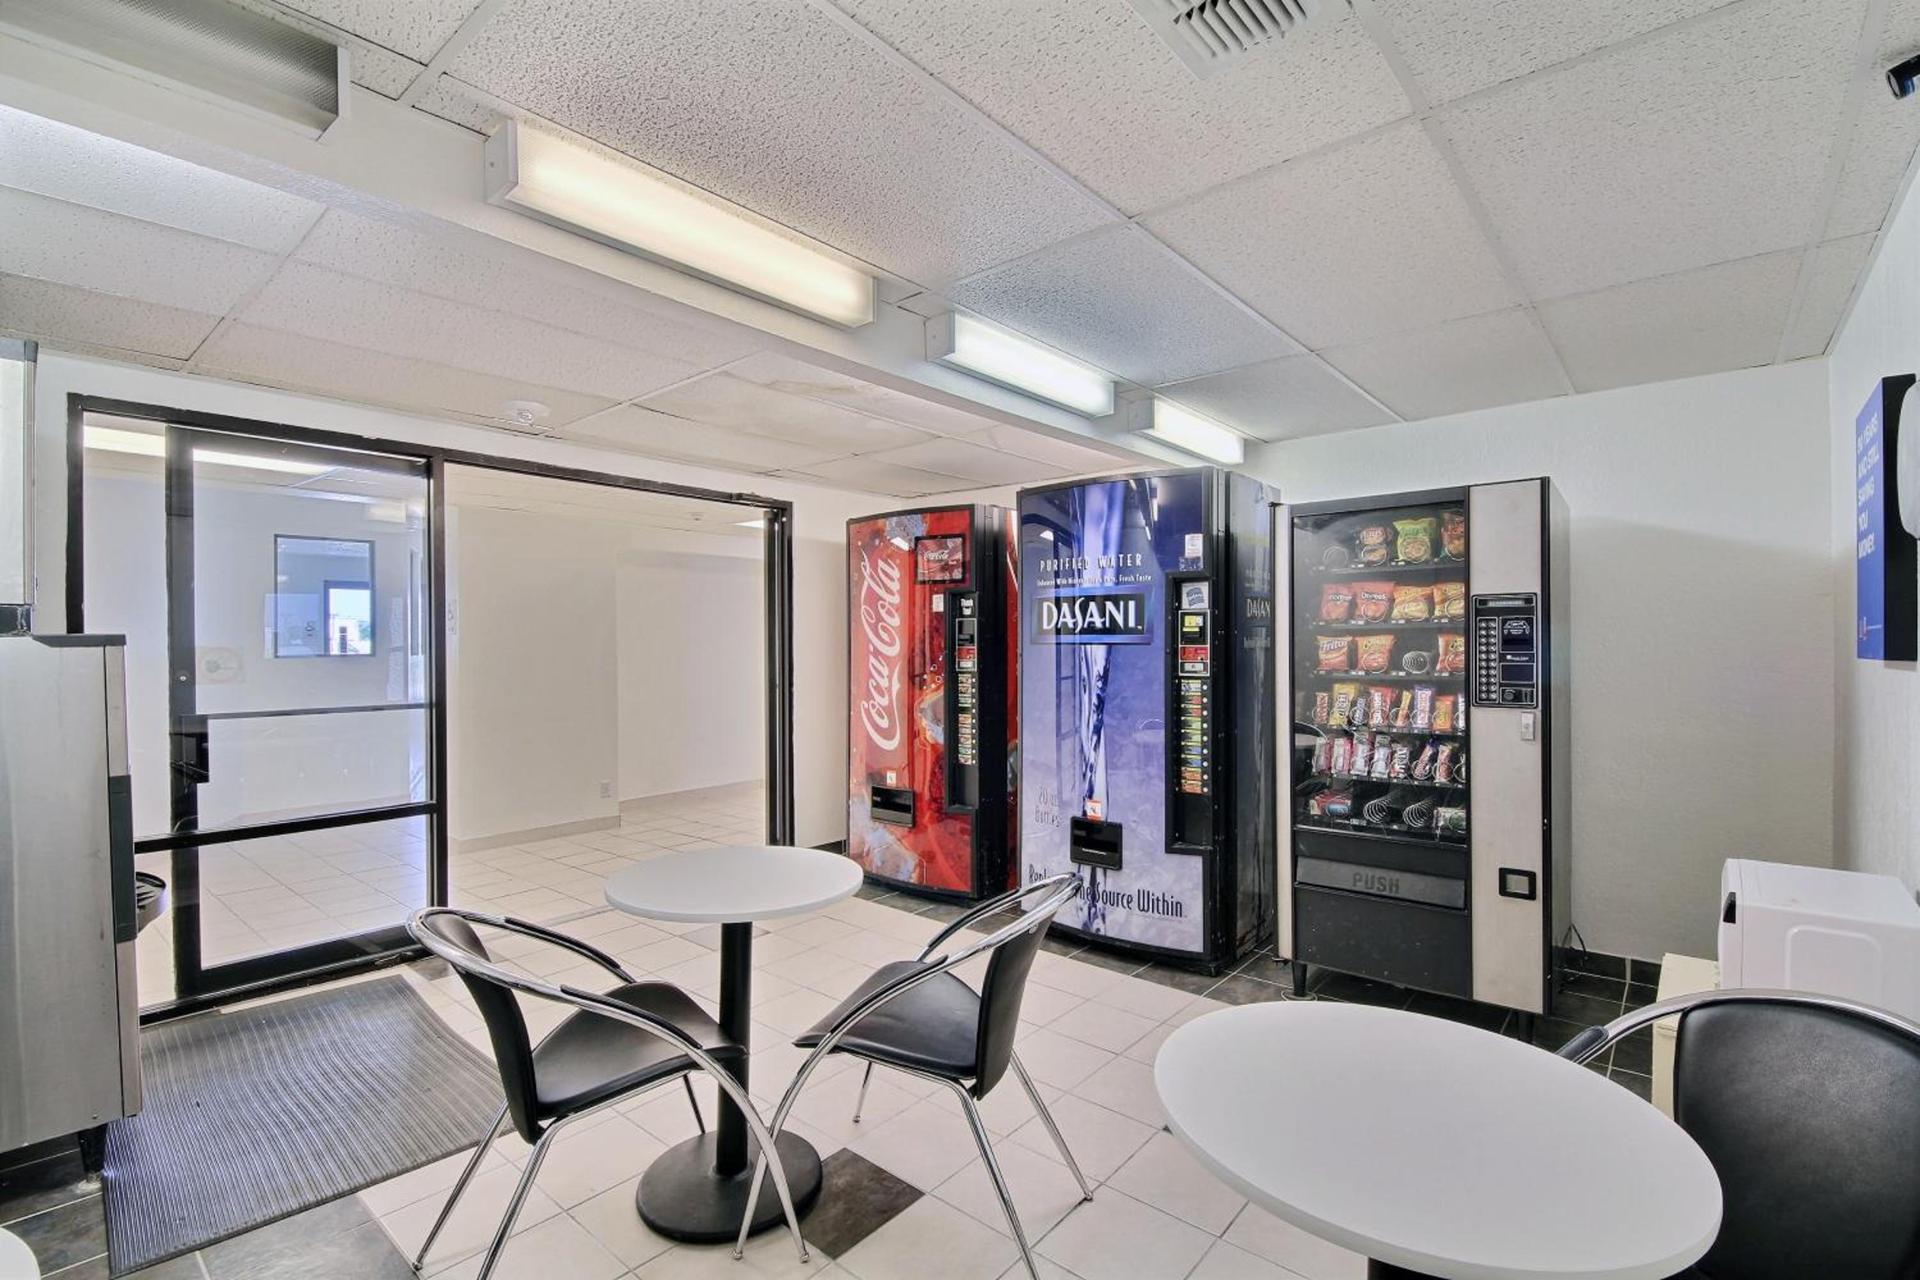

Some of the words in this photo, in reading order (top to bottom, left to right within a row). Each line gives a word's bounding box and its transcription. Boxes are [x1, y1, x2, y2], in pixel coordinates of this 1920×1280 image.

[1039, 556, 1090, 573] PURIFIED
[1097, 553, 1142, 570] WATER
[1042, 597, 1137, 634] DASANI
[859, 548, 901, 751] Coca-Cola
[1095, 881, 1133, 911] Source
[1137, 888, 1183, 918] Within
[1352, 872, 1401, 894] PUSH
